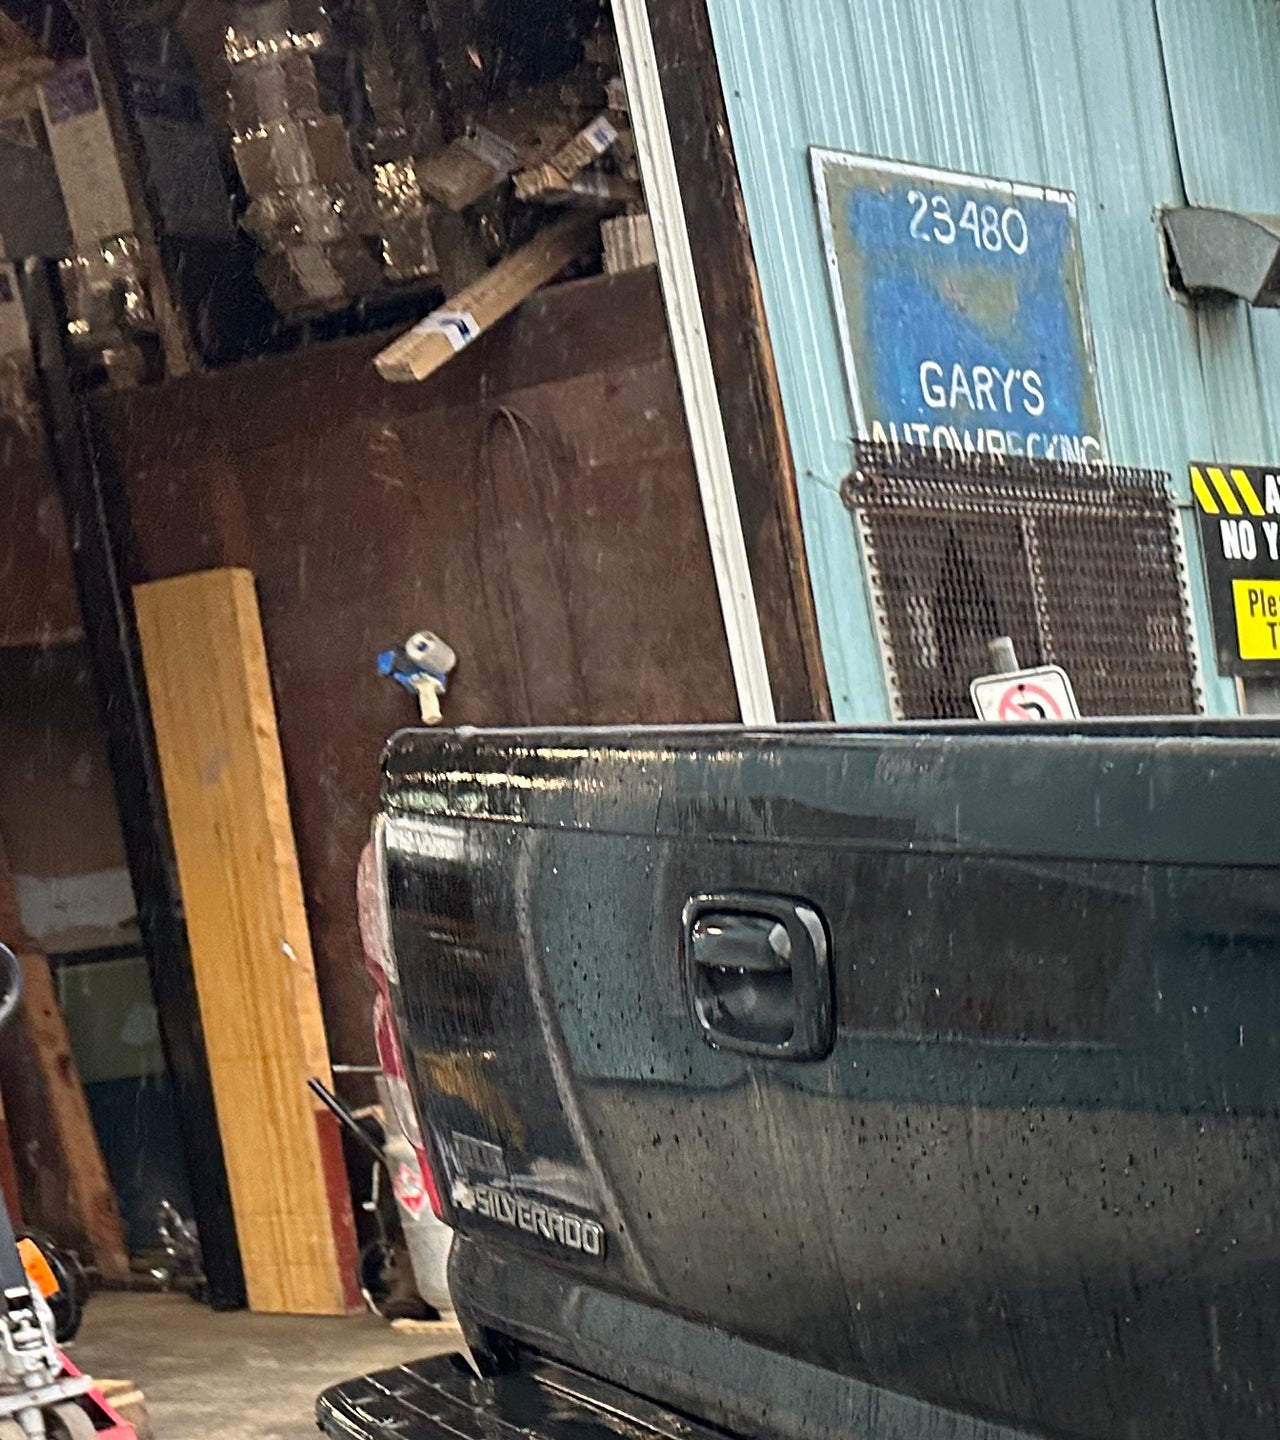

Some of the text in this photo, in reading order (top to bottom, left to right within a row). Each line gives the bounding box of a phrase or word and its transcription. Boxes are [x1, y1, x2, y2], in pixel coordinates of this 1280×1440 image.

[907, 190, 1029, 255] 23480
[920, 361, 1045, 416] GARY'S
[1220, 520, 1257, 559] NO
[476, 1184, 605, 1257] SILVERADO
